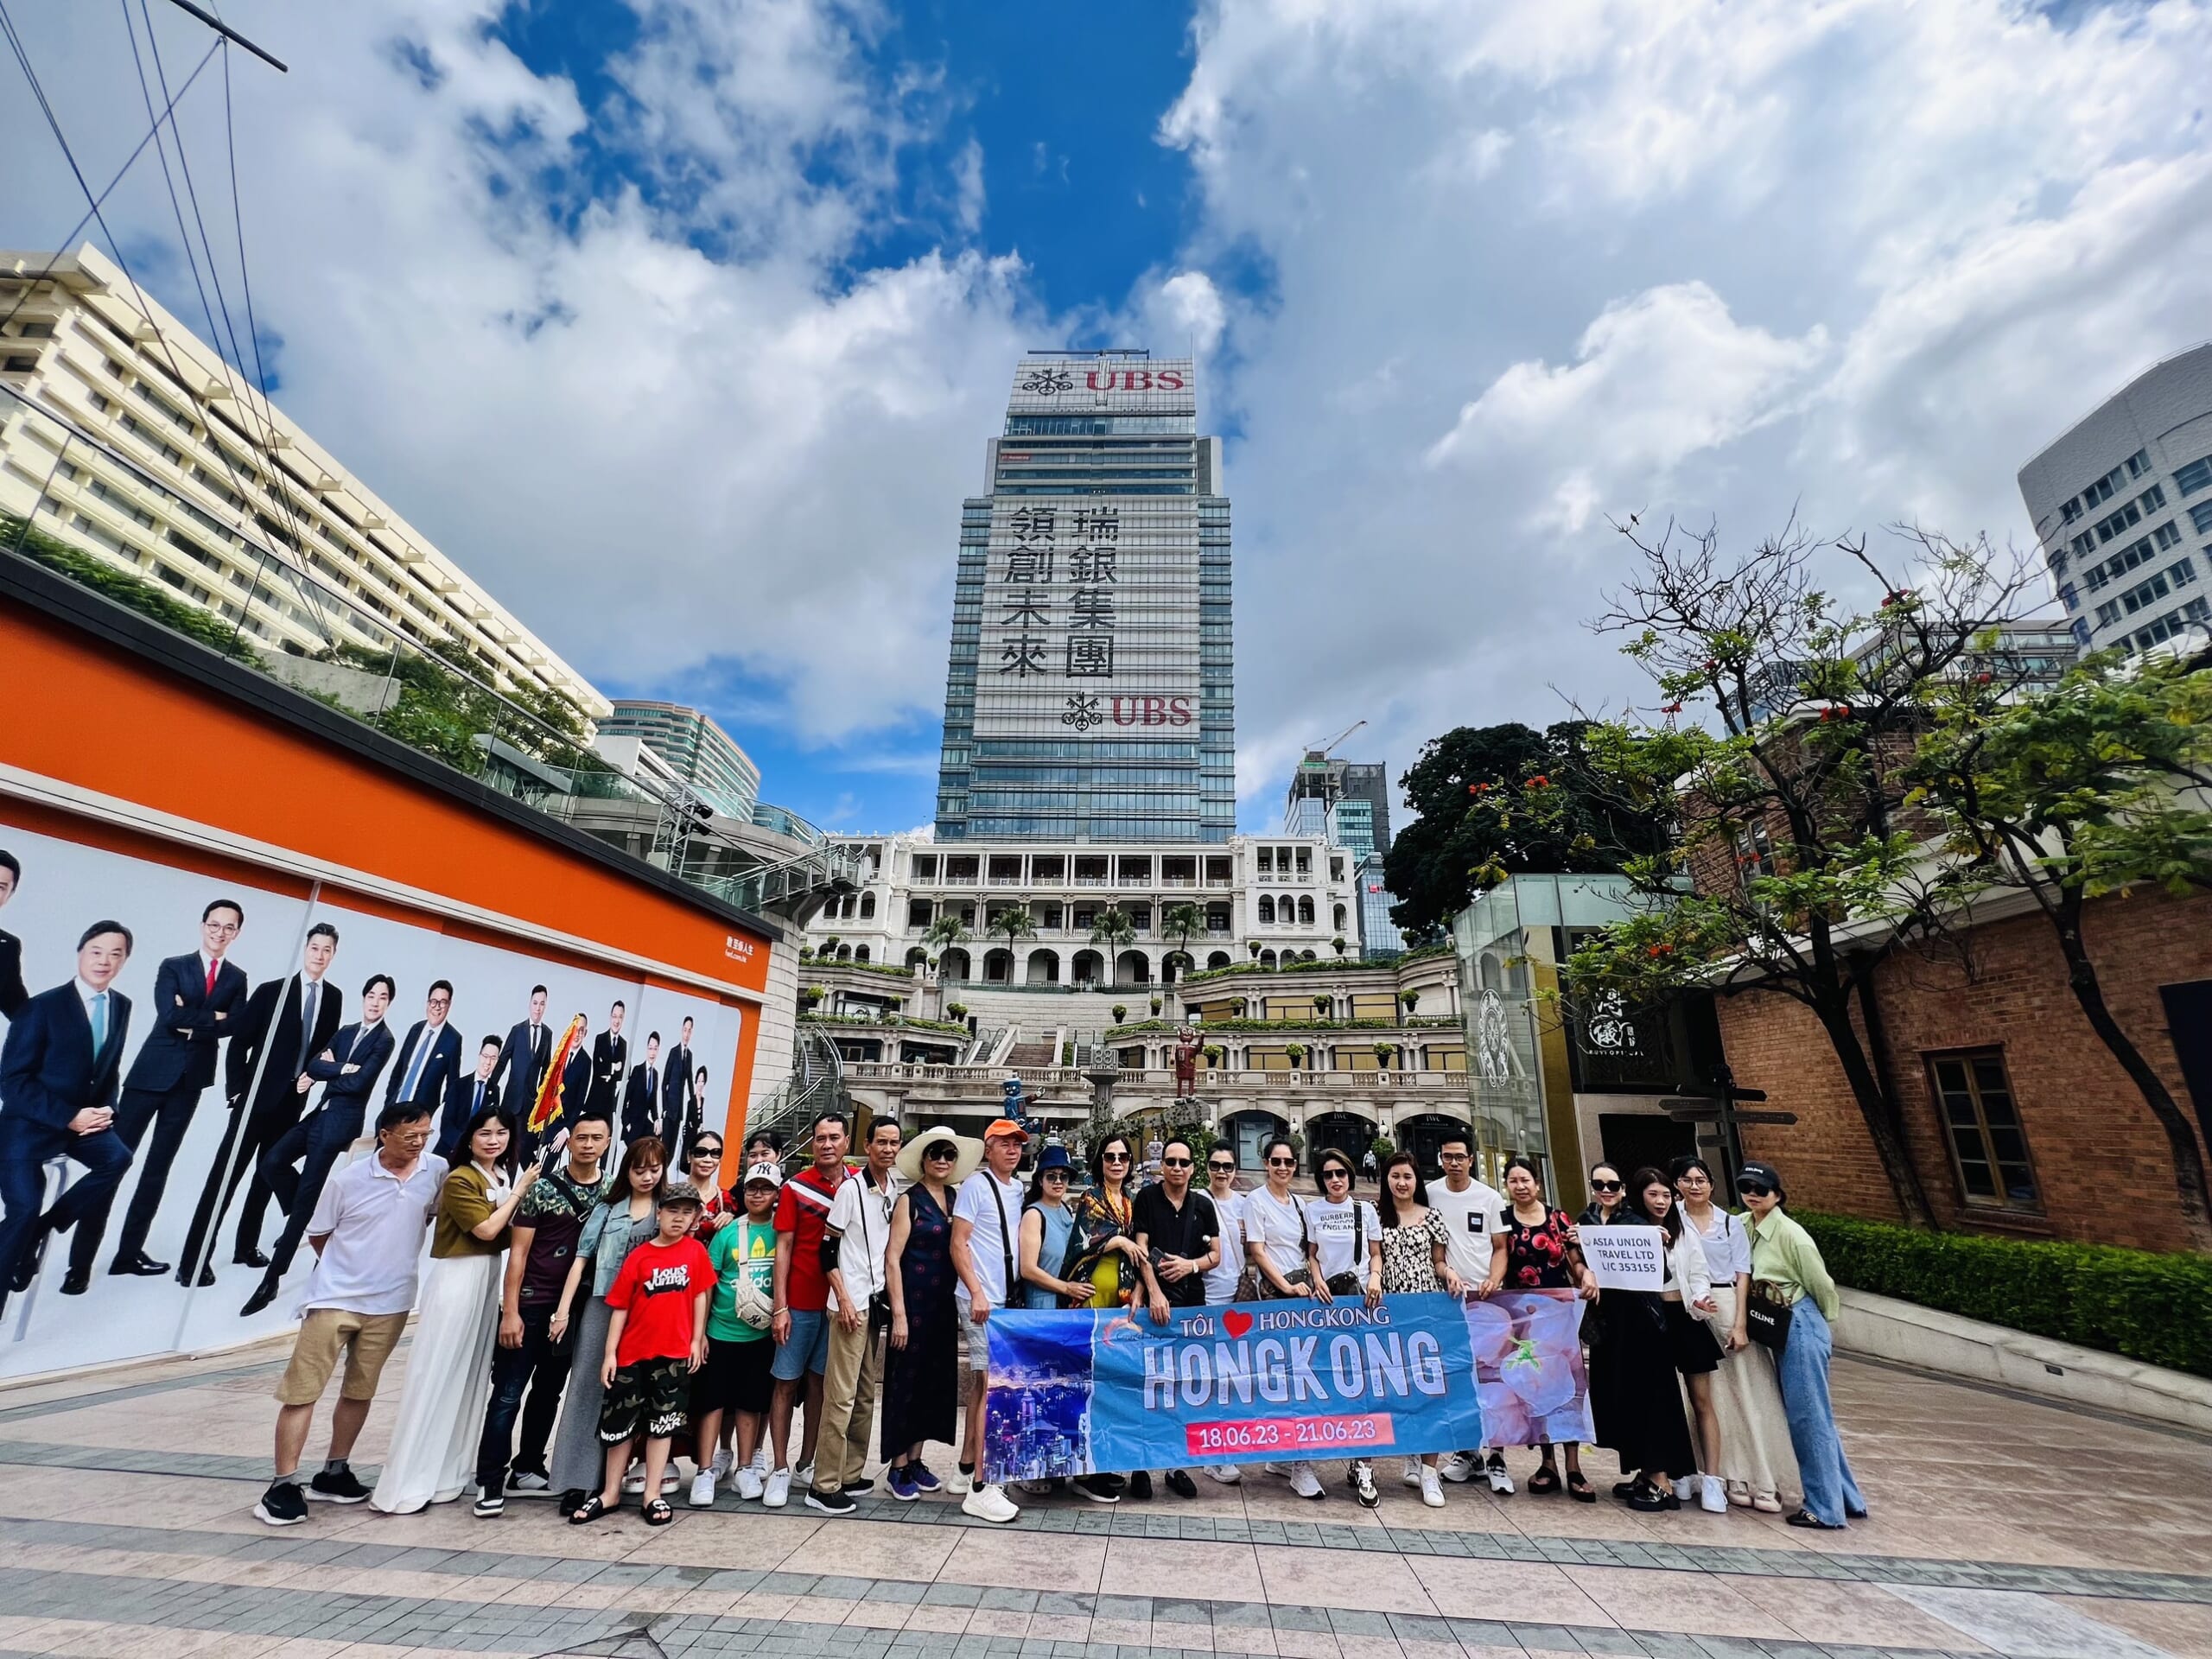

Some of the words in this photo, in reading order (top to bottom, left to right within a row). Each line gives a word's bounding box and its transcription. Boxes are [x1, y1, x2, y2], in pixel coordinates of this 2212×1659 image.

[1084, 371, 1184, 391] UBS
[997, 505, 1058, 678] 領創未來
[1065, 505, 1119, 679] 瑞銀集團
[1110, 696, 1192, 727] UBS
[1320, 1212, 1354, 1222] BURBERR
[1592, 1237, 1614, 1247] ASIA
[1617, 1237, 1651, 1247] UNION
[1597, 1249, 1633, 1260] TRAVEL
[1635, 1250, 1655, 1260] LTD
[1601, 1262, 1617, 1272] L/C
[1618, 1262, 1656, 1273] 353155
[1180, 1313, 1215, 1337] TÔI
[1259, 1306, 1390, 1332] HONGKONG
[1750, 1309, 1775, 1325] CELINE
[1144, 1332, 1446, 1409] HONGKONG
[1199, 1424, 1280, 1450] 18.06.23
[1295, 1420, 1376, 1445] 21.06.23
